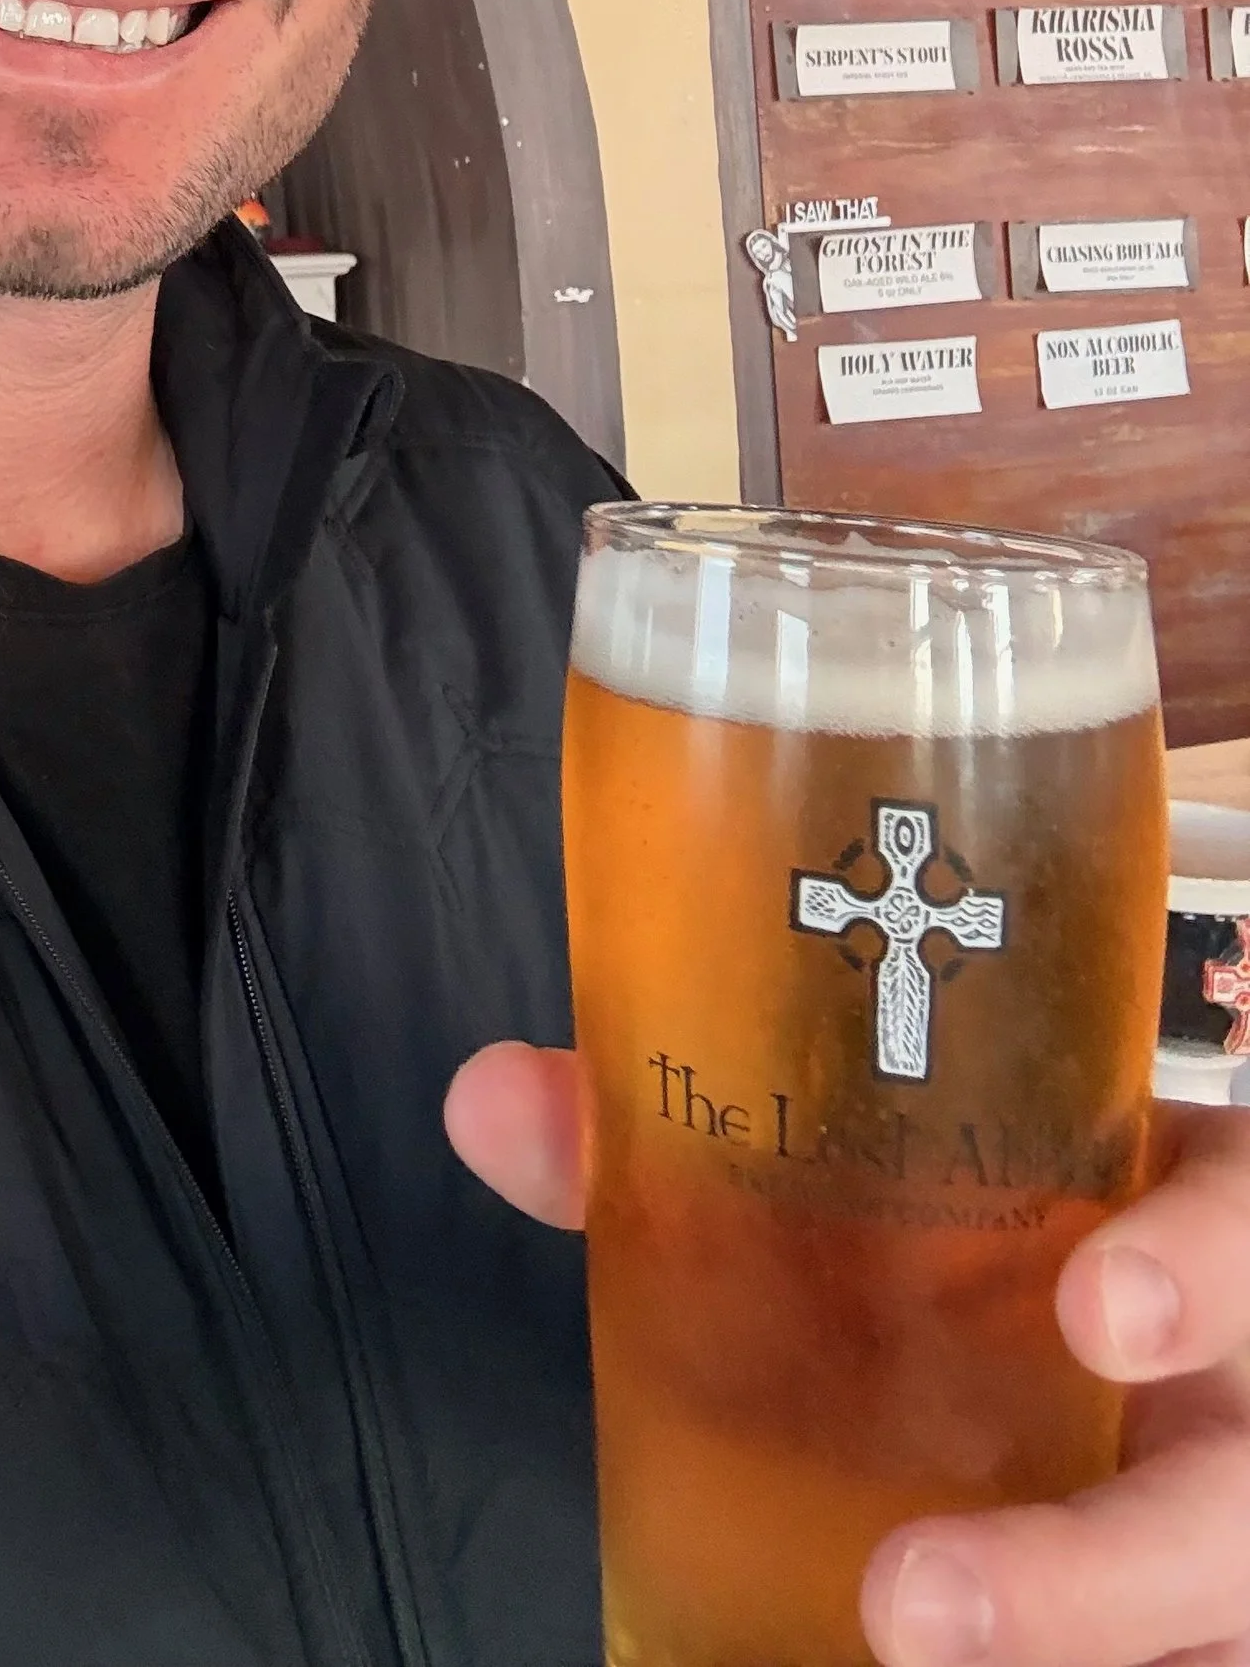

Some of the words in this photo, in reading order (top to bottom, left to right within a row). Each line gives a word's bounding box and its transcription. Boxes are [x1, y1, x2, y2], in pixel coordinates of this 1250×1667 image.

[1032, 8, 1155, 34] KHARISMA
[805, 46, 894, 68] SERPENT'S
[897, 45, 949, 64] STOUT
[1056, 36, 1134, 62] ROSSA
[794, 199, 832, 223] SAW
[835, 196, 879, 221] THAT
[822, 235, 897, 259] GHOST
[901, 232, 923, 252] IN
[925, 229, 970, 250] THE
[1046, 243, 1113, 264] CHASING
[1116, 241, 1184, 262] BUFFALO
[856, 251, 937, 275] FOREST
[1046, 337, 1080, 361] NON
[1085, 331, 1180, 358] ALCOHOLIC
[841, 351, 895, 377] HOLY
[900, 347, 973, 372] WATER
[1092, 356, 1136, 378] BEER
